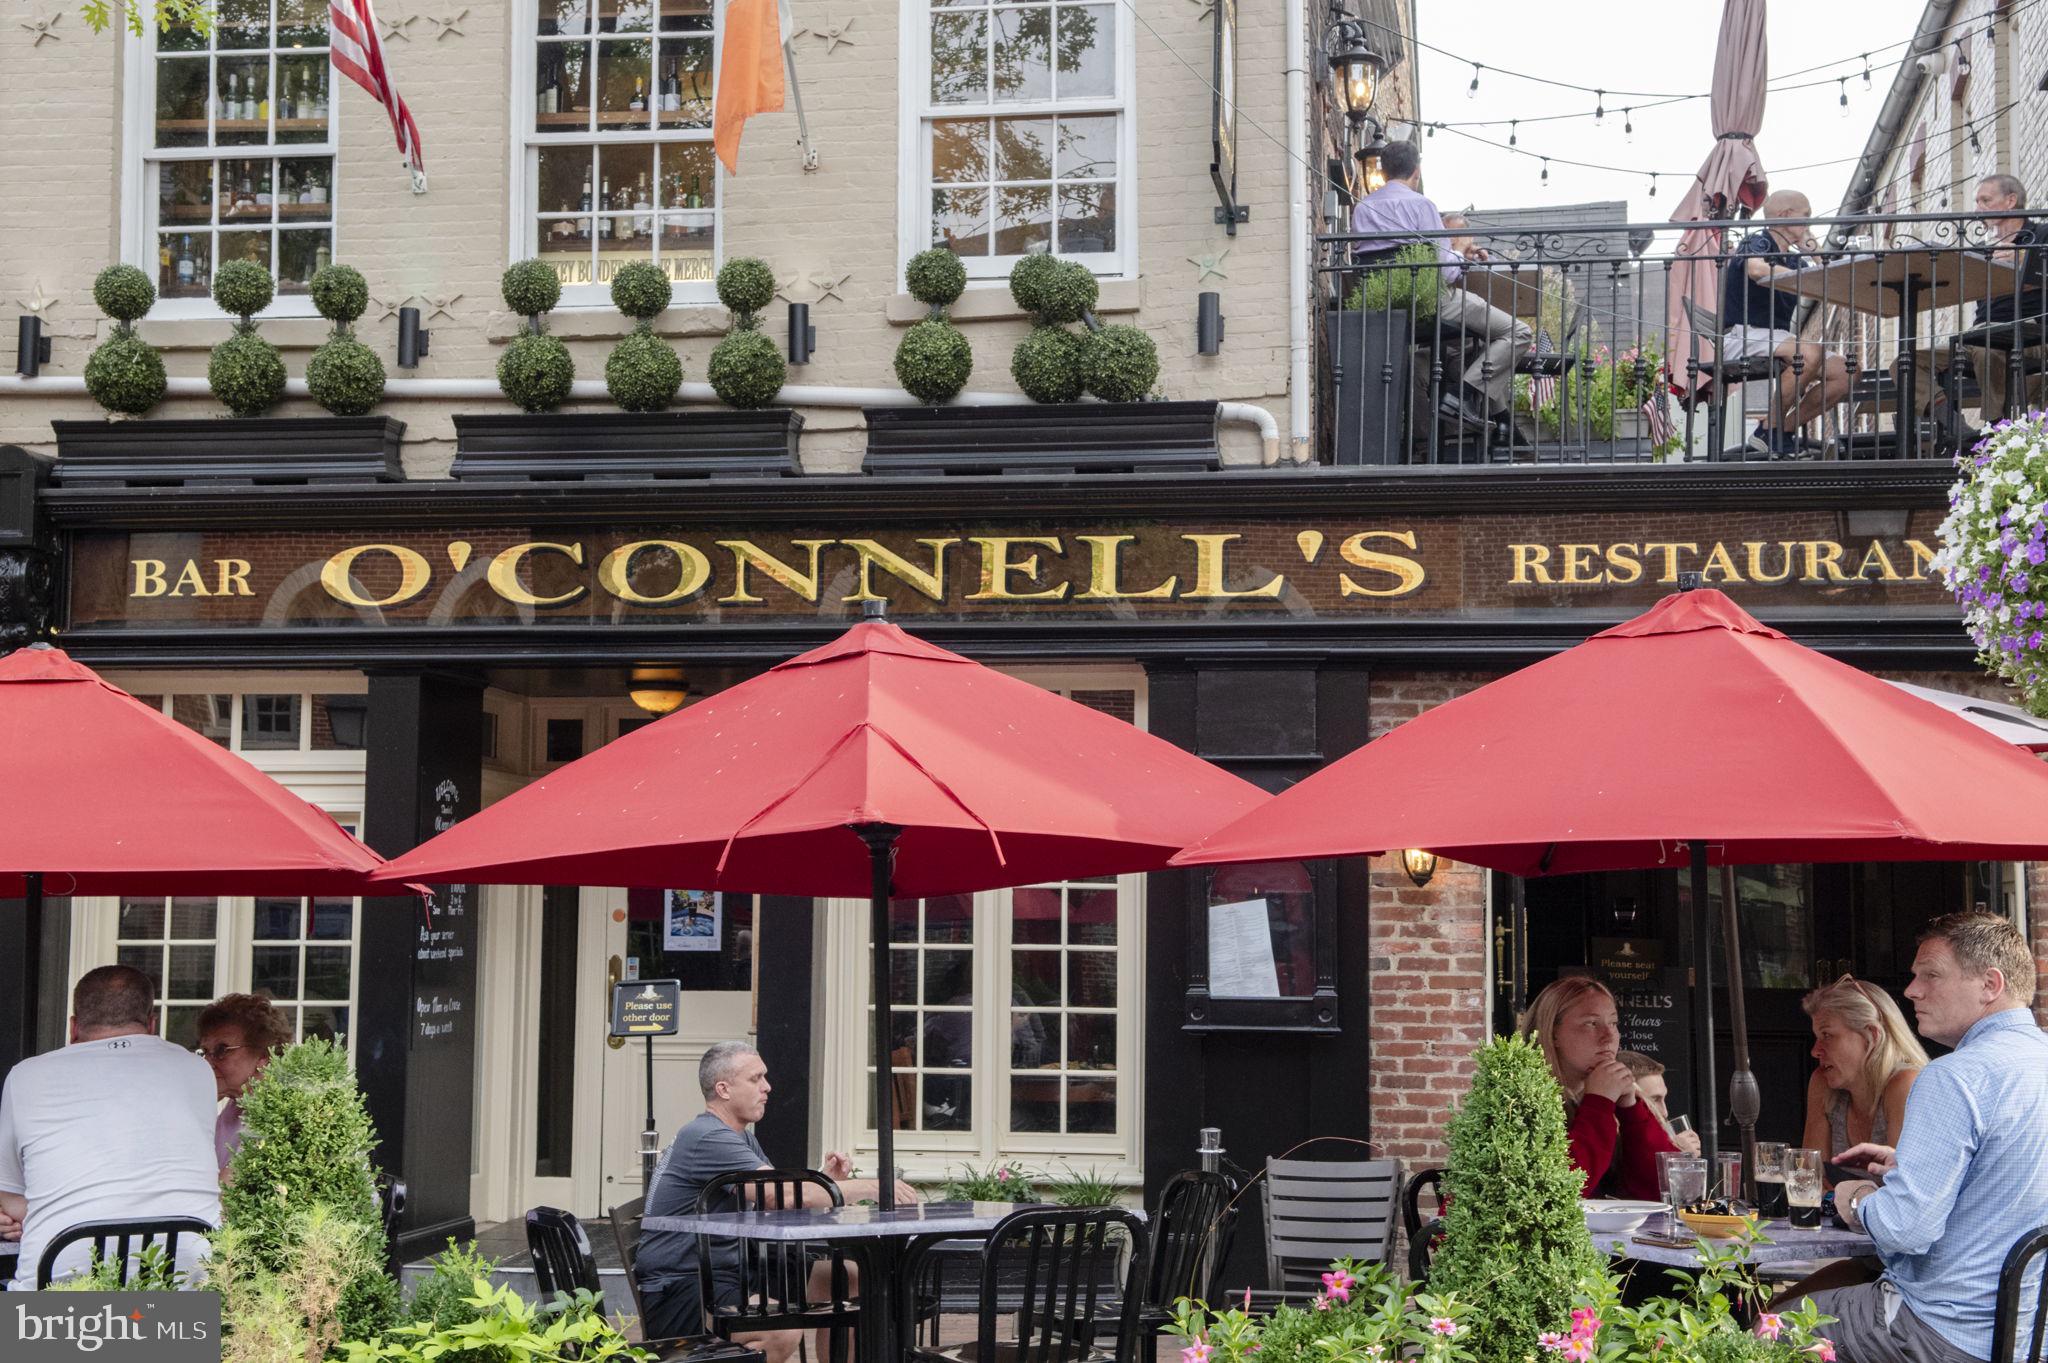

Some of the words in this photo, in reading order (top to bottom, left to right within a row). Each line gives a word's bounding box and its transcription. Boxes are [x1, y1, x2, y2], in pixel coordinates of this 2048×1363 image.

[319, 530, 1427, 608] O'CONNELL'S
[131, 558, 256, 598] BAR
[1600, 959, 1633, 969] Please
[1635, 960, 1656, 970] seat
[1609, 971, 1650, 981] yourself
[625, 1002, 654, 1011] Please
[656, 1002, 673, 1011] use
[623, 1013, 647, 1022] other
[649, 1013, 671, 1022] door
